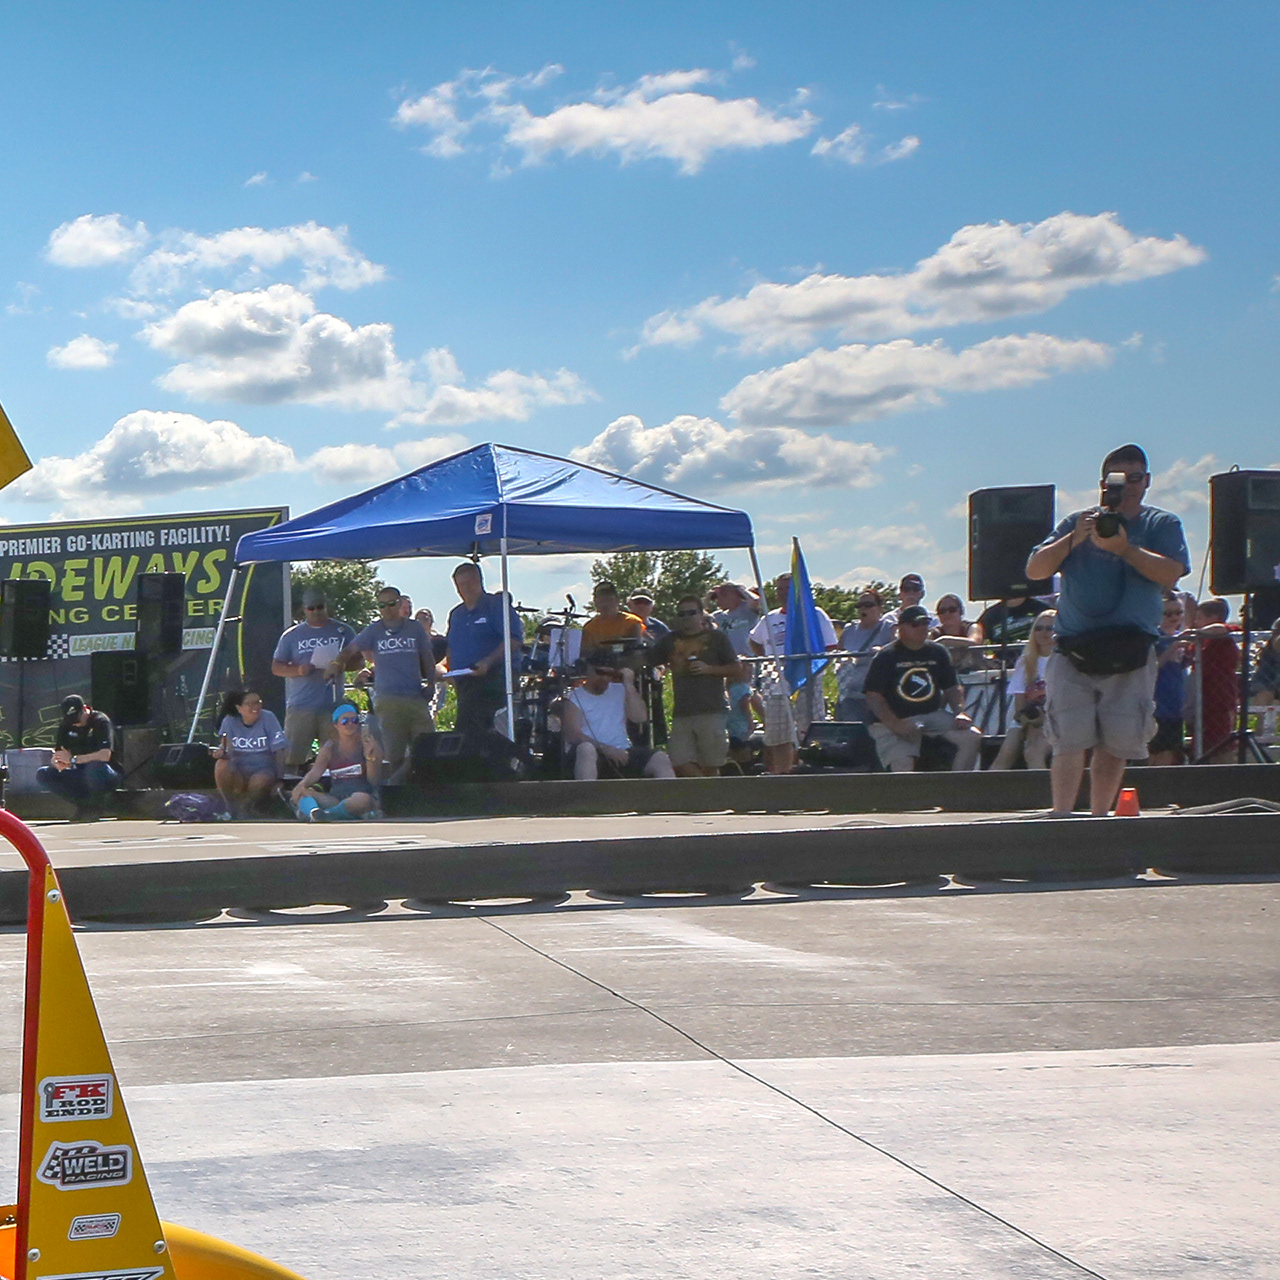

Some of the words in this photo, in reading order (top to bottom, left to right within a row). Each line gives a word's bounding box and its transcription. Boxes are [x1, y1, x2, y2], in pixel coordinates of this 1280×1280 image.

[0, 538, 61, 557] PREMIER
[66, 531, 155, 552] GO-KARTING
[160, 525, 231, 546] FACILITY!
[52, 1083, 106, 1100] FK
[58, 1099, 107, 1110] ROD
[45, 1108, 107, 1118] ENDS
[64, 1154, 126, 1175] WELD
[64, 1172, 124, 1183] RACING
